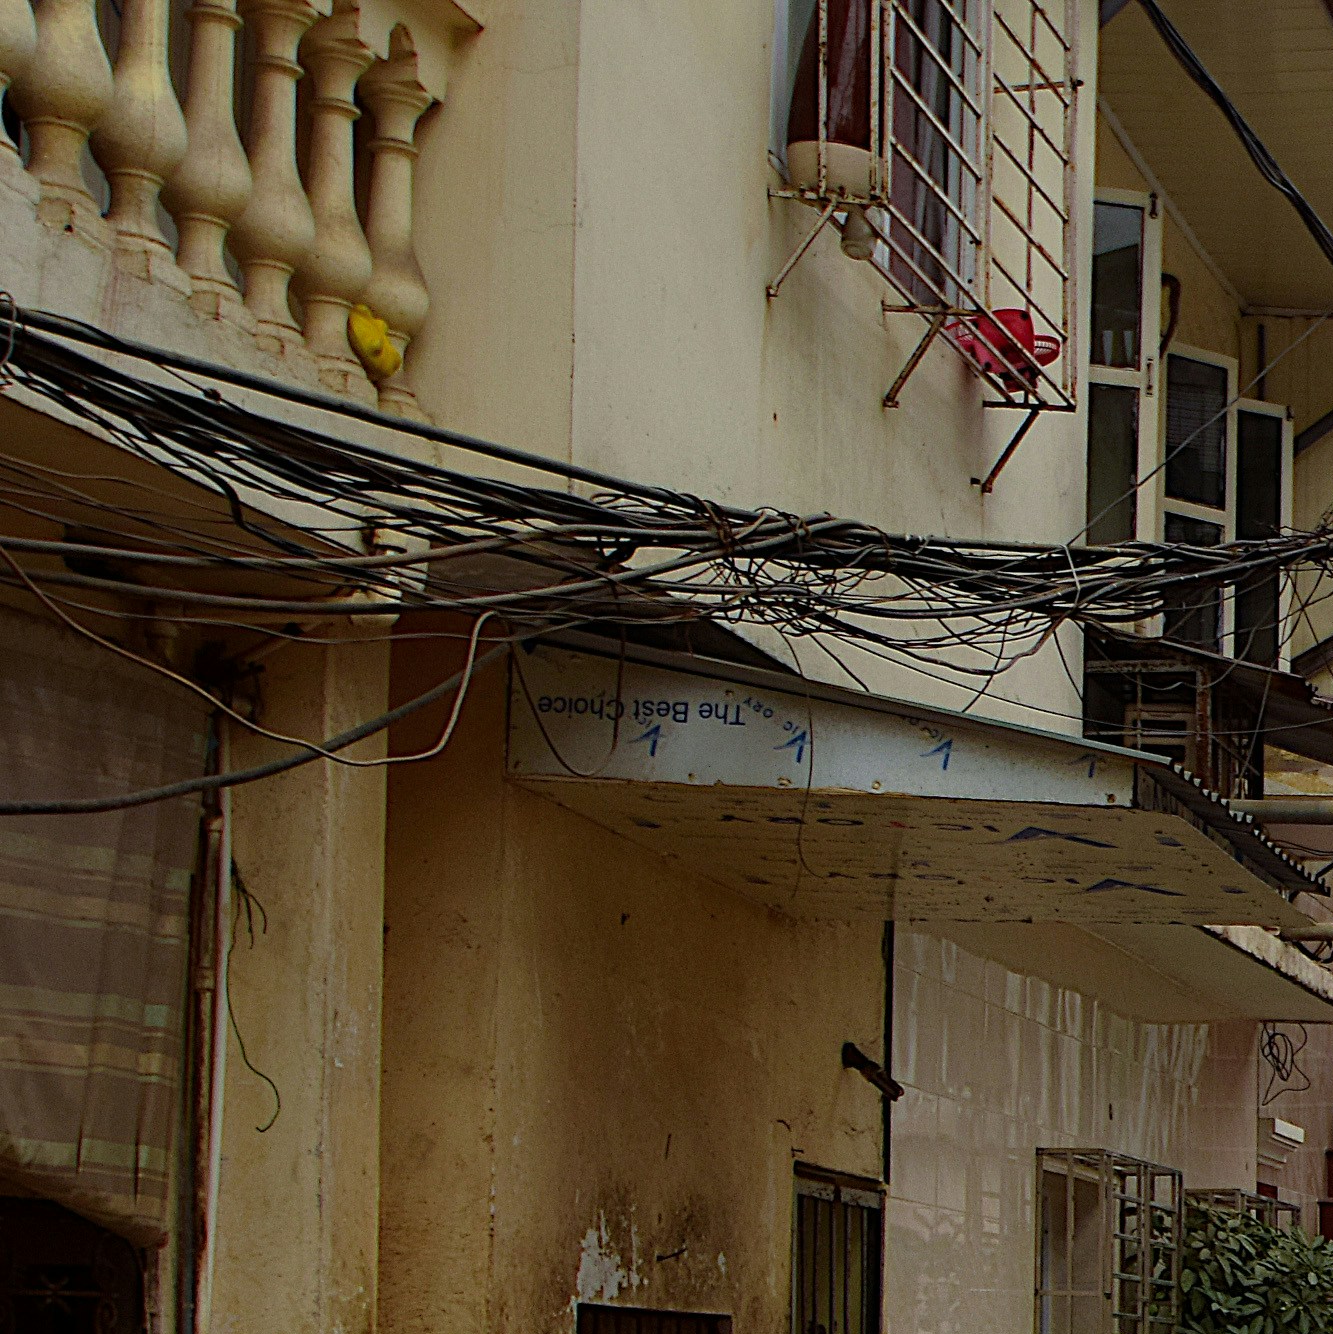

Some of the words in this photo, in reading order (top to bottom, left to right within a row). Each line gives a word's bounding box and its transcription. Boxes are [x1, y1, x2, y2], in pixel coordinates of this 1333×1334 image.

[537, 695, 625, 721] Choice
[633, 699, 689, 724] Best
[698, 702, 746, 727] The
